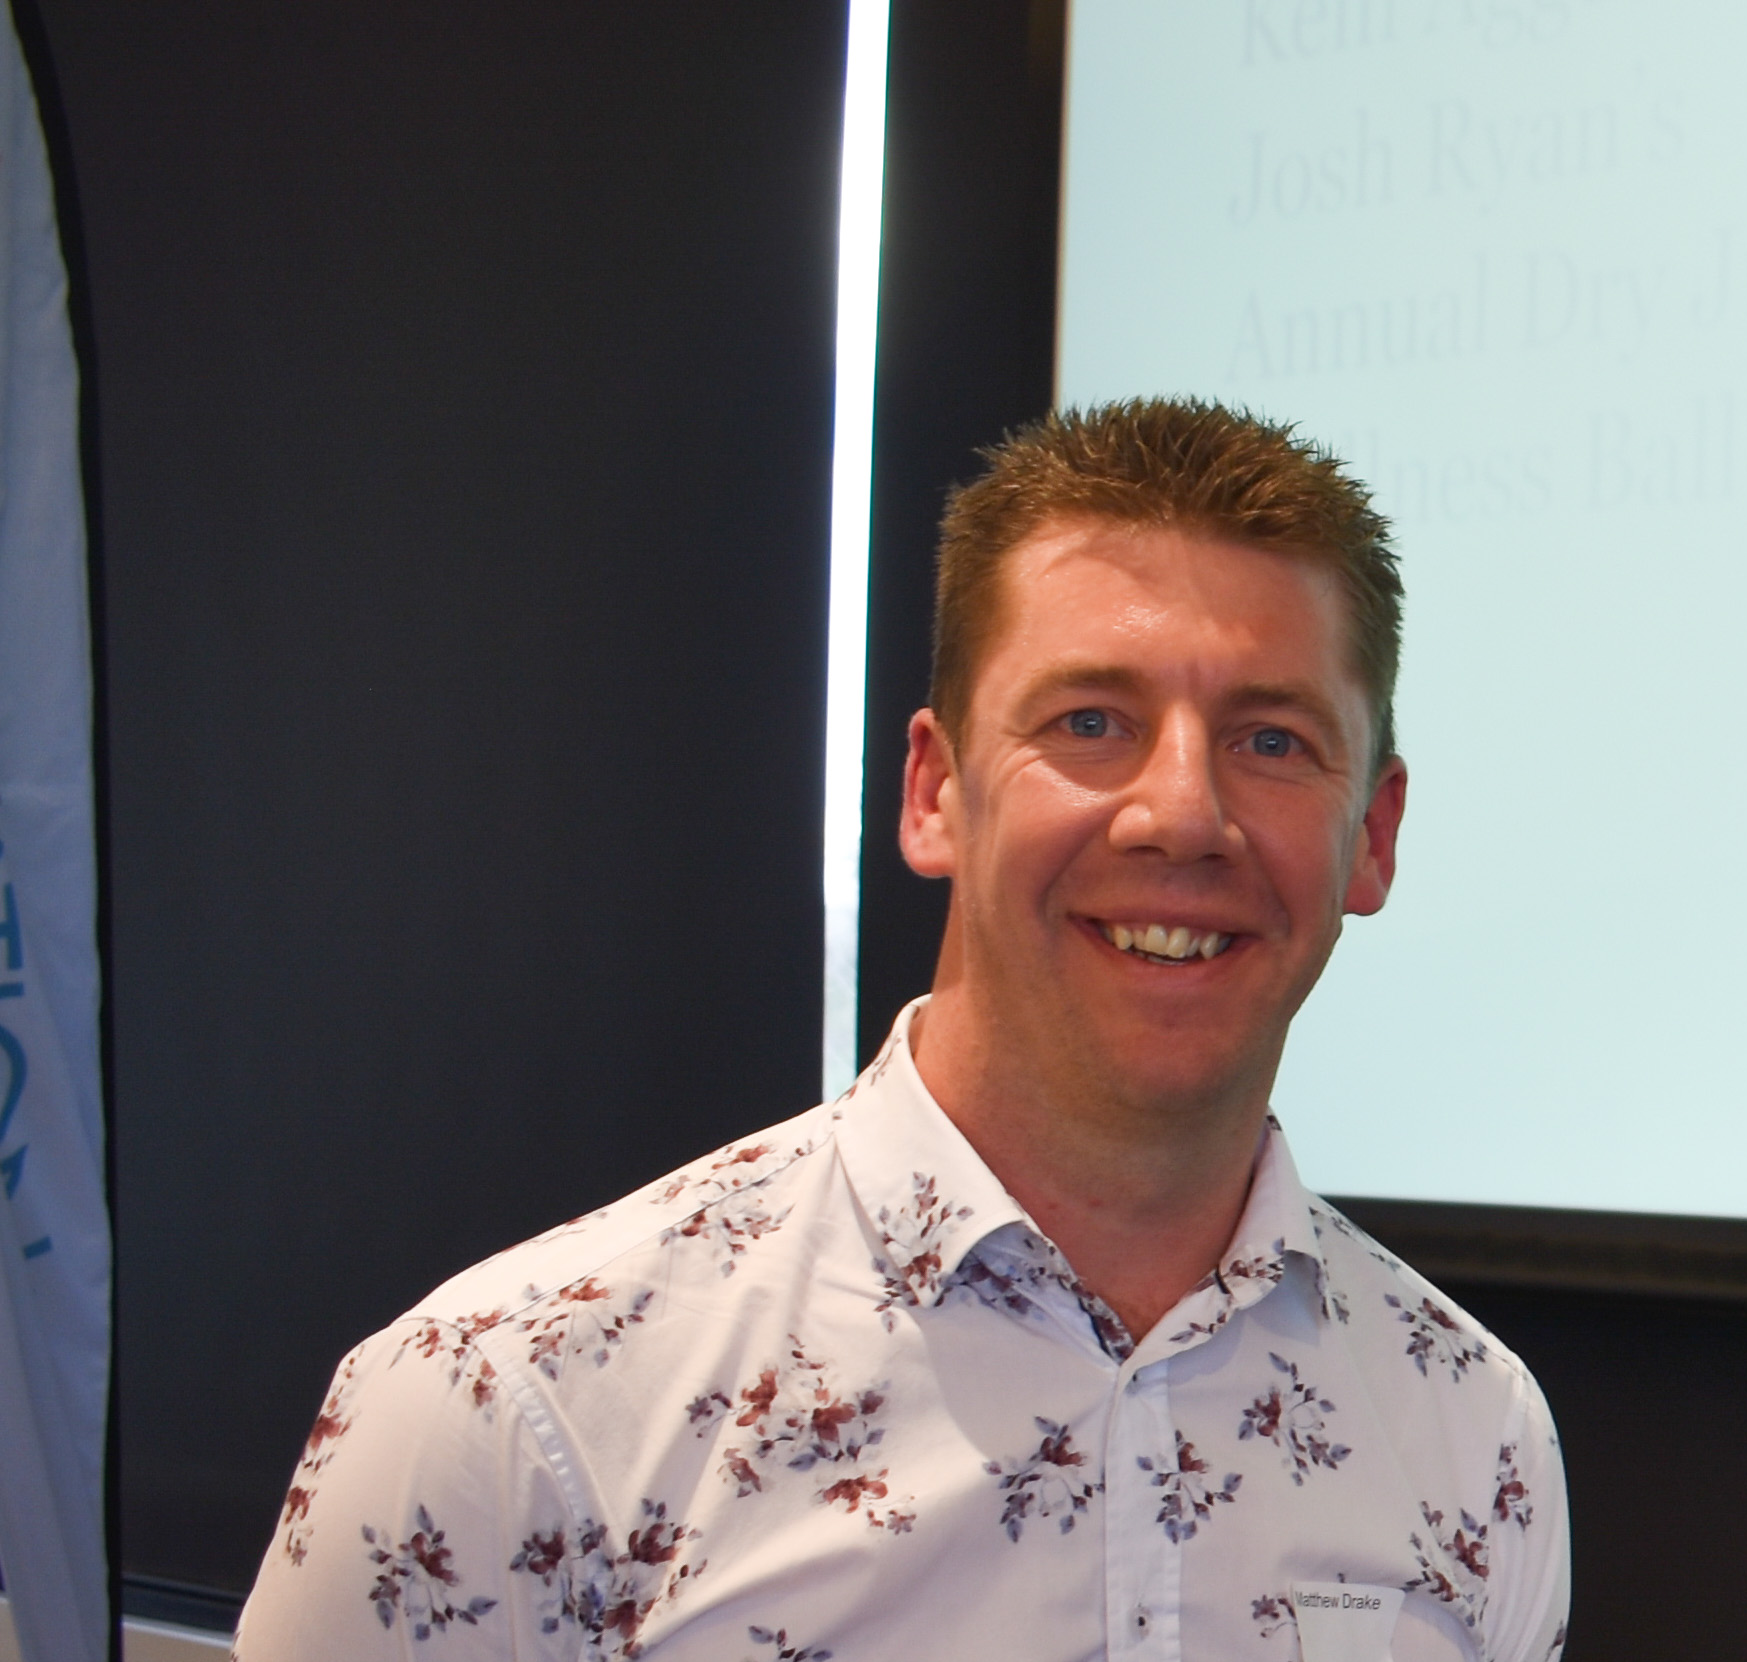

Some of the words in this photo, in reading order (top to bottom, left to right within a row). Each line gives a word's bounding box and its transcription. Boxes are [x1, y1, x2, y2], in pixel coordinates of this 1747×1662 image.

[1226, 107, 1397, 228] Josh
[1426, 62, 1689, 217] Ryan's
[1222, 252, 1492, 384] Annual
[1521, 249, 1668, 366] Dry
[1585, 388, 1737, 513] Ball
[1342, 1593, 1381, 1610] Drake
